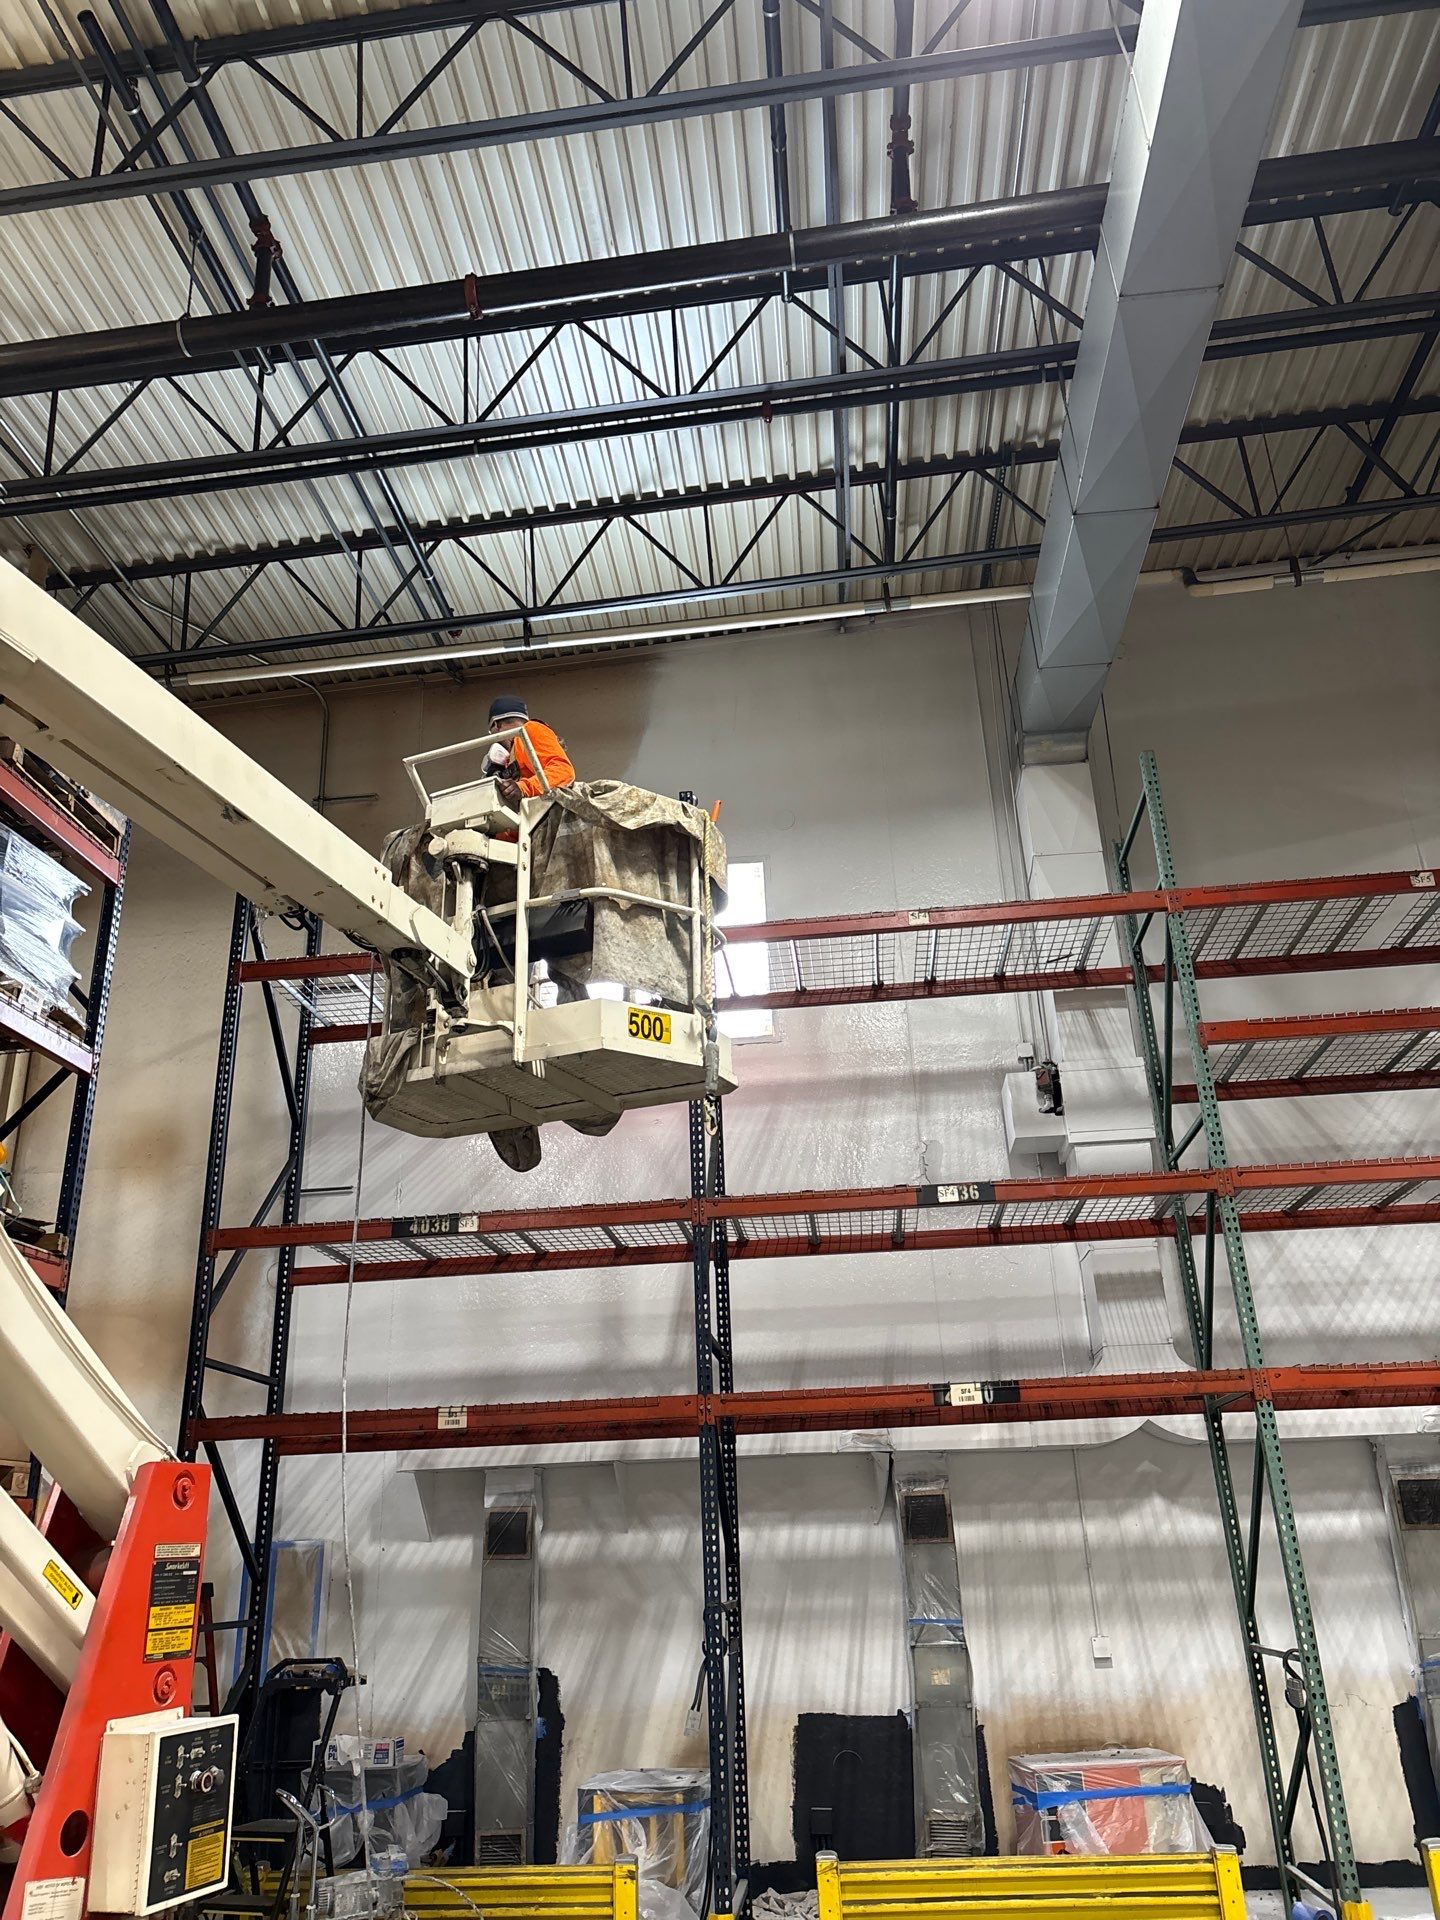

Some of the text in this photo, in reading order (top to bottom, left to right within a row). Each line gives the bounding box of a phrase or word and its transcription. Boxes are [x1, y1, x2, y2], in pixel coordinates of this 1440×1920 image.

[628, 1012, 664, 1041] 500
[938, 1187, 955, 1198] SF4
[409, 1217, 450, 1235] 4038
[459, 1218, 475, 1228] SF3
